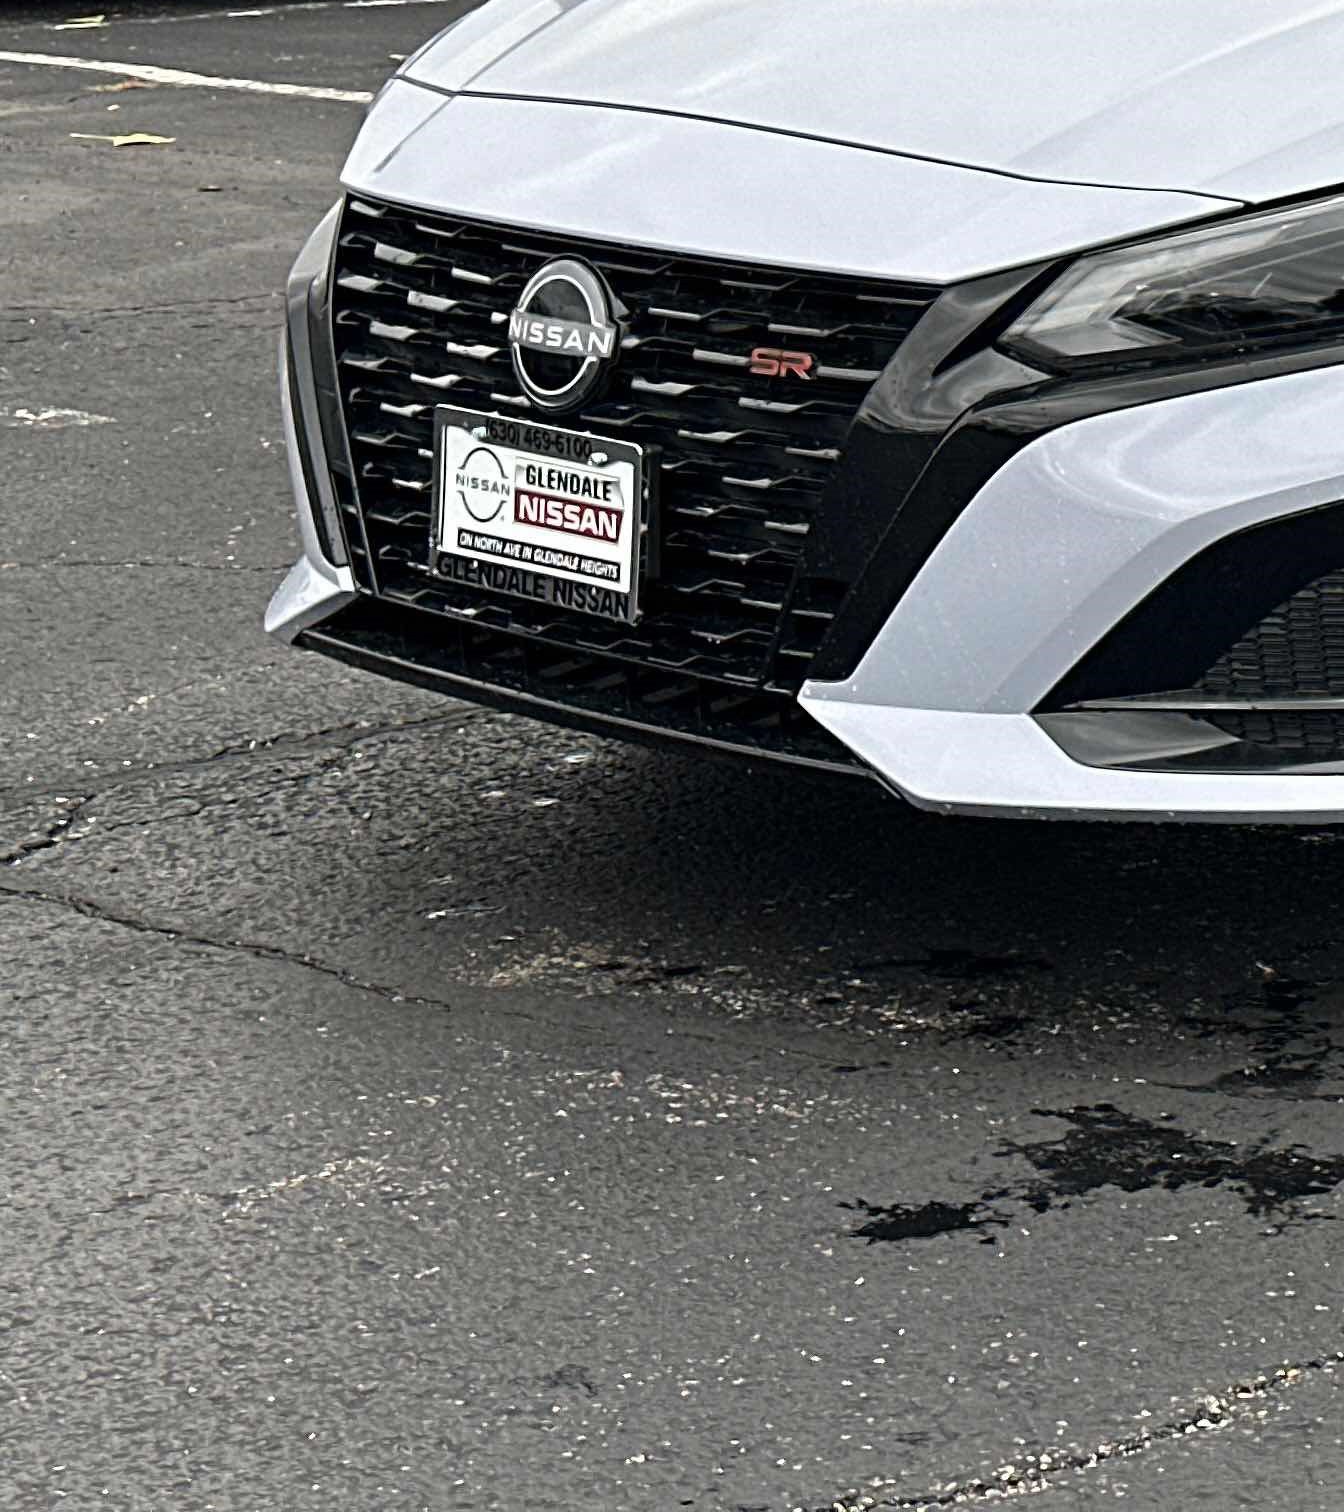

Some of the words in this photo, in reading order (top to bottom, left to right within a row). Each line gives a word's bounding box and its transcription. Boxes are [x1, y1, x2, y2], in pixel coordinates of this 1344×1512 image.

[508, 315, 613, 354] NISSAN
[750, 347, 815, 380] SR
[486, 417, 520, 447] (630)
[524, 426, 593, 459] 469-6100
[455, 472, 510, 496] NISSAN
[525, 464, 612, 502] GLENDALE
[518, 494, 618, 540] NISSAN
[459, 532, 473, 547] ON
[474, 536, 502, 554] NORTH
[503, 543, 521, 559] AVE
[522, 547, 532, 561] IN
[533, 550, 579, 572] GLENDALE
[580, 558, 619, 580] HEIGHTS
[440, 554, 546, 600] GLENDALE
[552, 579, 630, 619] NISSAN
